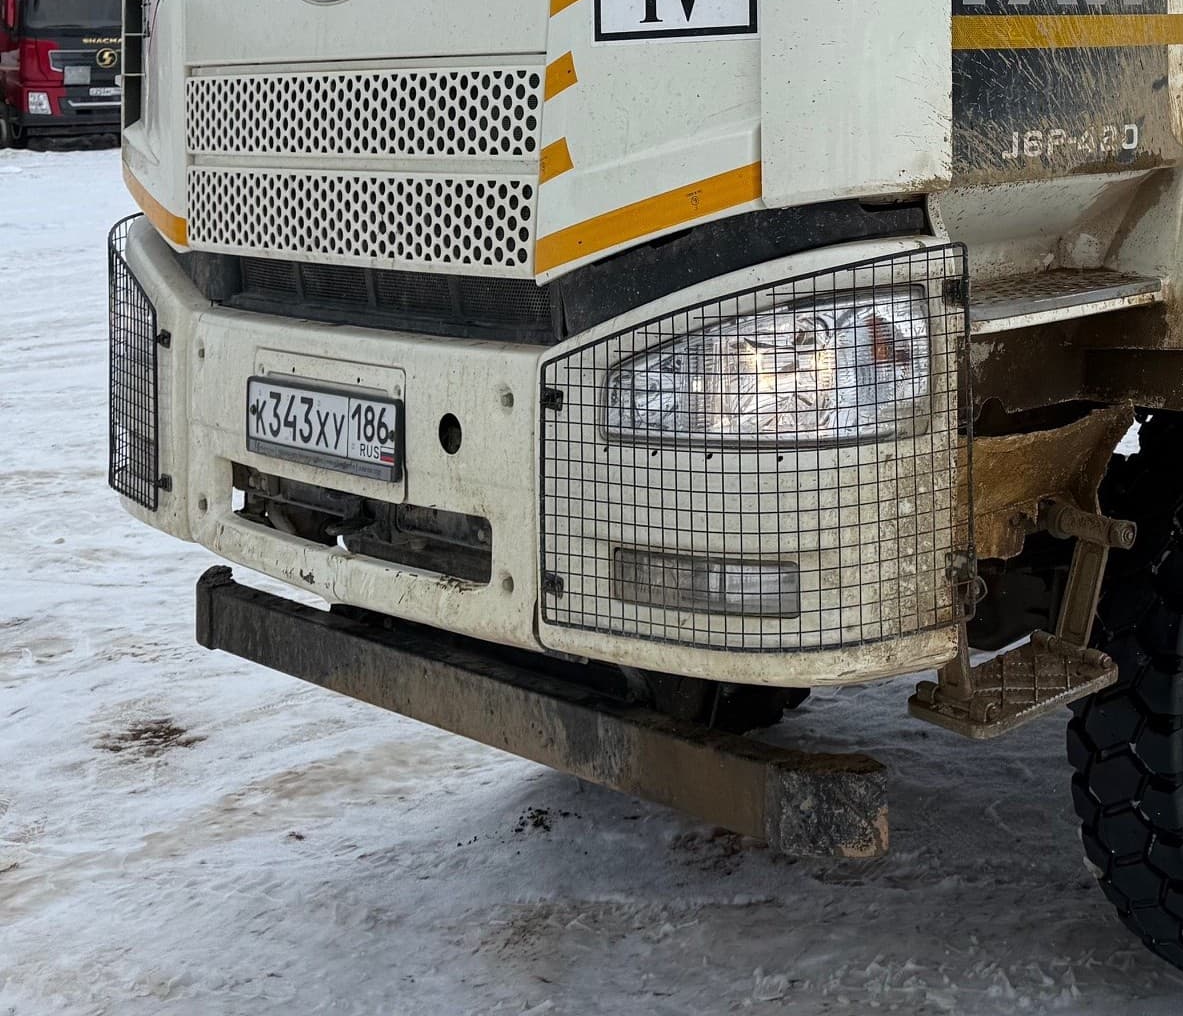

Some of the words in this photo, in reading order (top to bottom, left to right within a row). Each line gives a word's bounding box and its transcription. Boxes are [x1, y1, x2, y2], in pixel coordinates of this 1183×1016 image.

[82, 37, 122, 45] SHACMA
[351, 402, 390, 445] 186
[359, 443, 380, 460] RUS
